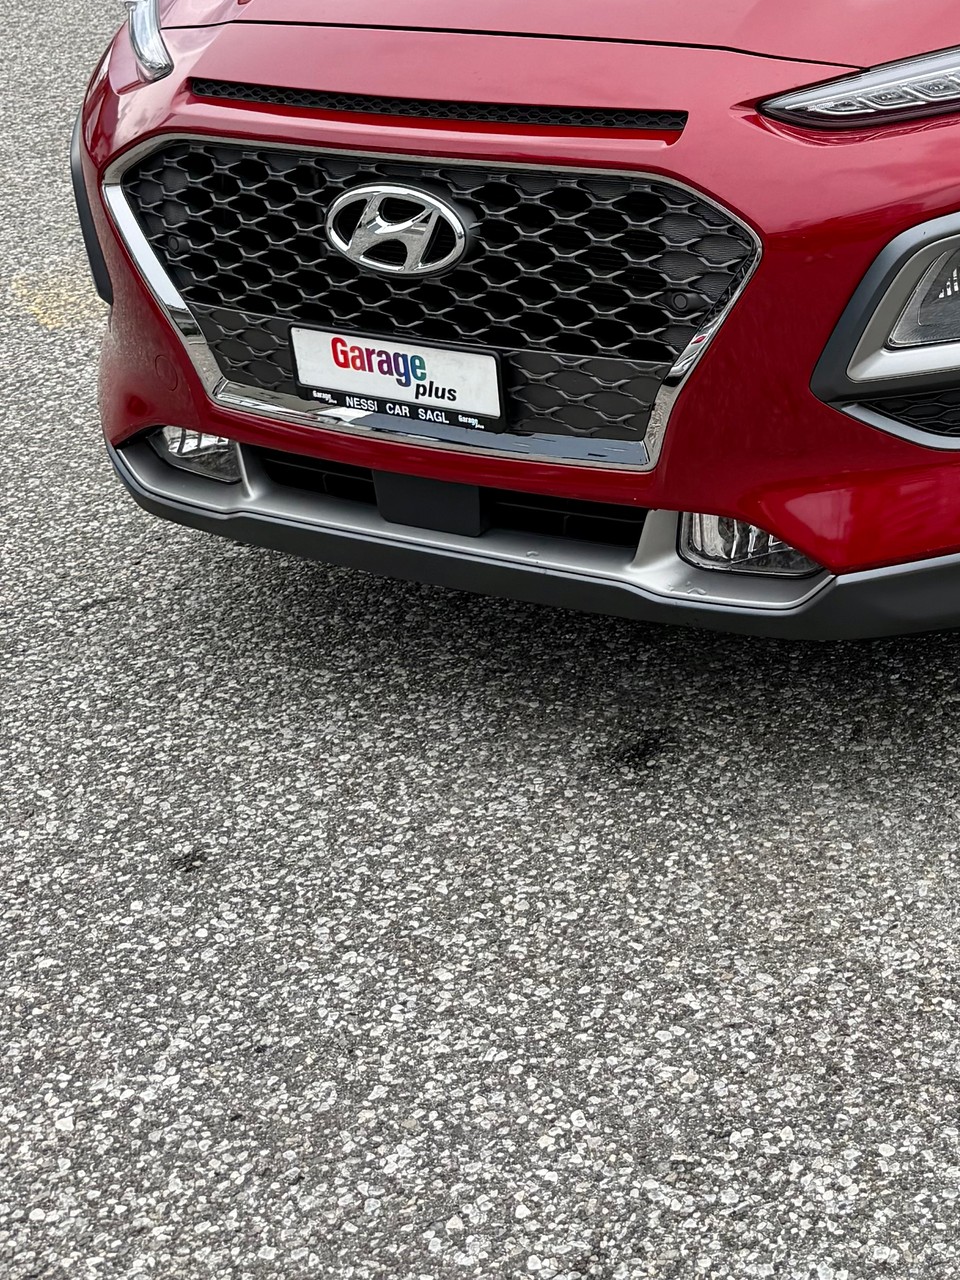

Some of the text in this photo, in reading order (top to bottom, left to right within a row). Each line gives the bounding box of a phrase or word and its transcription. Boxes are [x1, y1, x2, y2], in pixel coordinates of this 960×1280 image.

[330, 337, 427, 387] Garage
[414, 381, 457, 401] plus
[345, 396, 378, 412] NESSI
[386, 403, 410, 417] CAR
[418, 408, 449, 424] SAGL
